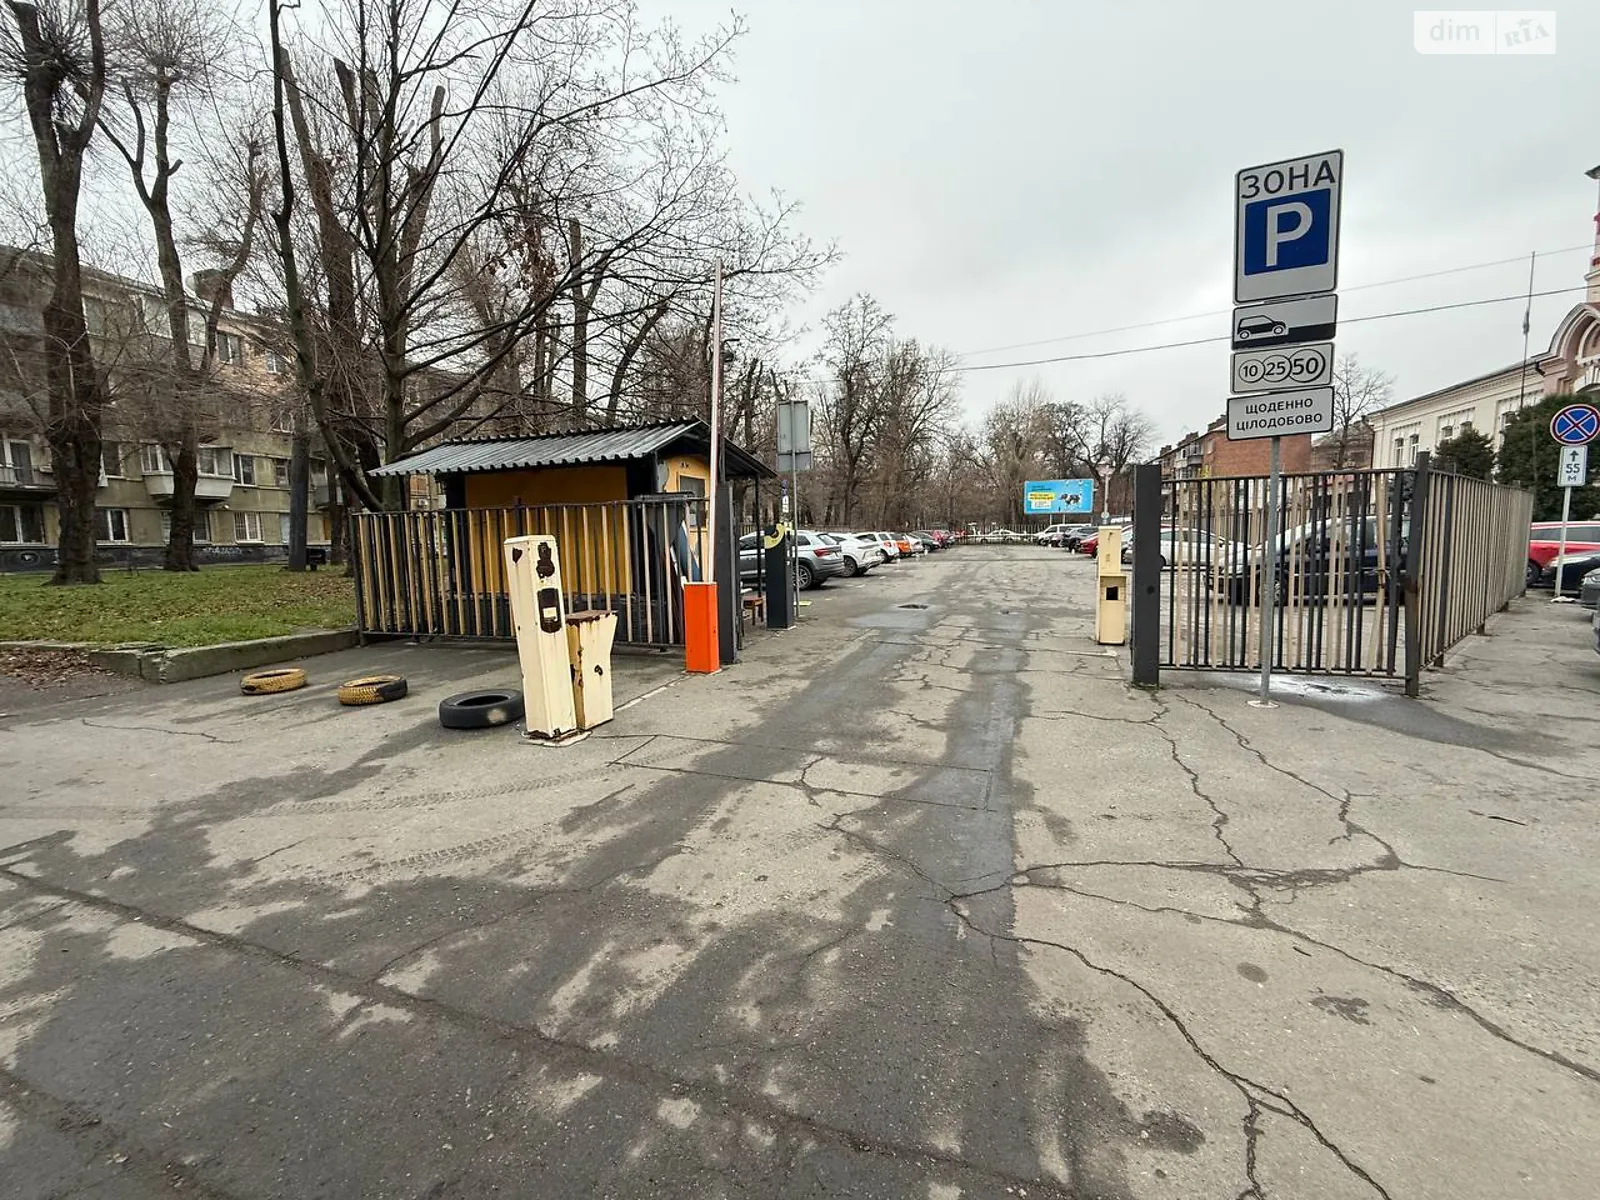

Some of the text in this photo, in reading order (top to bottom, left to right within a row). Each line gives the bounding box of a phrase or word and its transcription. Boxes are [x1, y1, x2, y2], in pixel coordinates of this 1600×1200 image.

[1241, 160, 1335, 199] ЗОНА
[1244, 357, 1317, 377] 10 25 50
[1246, 398, 1313, 414] ЩОДЕННО
[1237, 413, 1322, 431] ЦІЛОДОБОВО
[1565, 463, 1580, 473] 55
